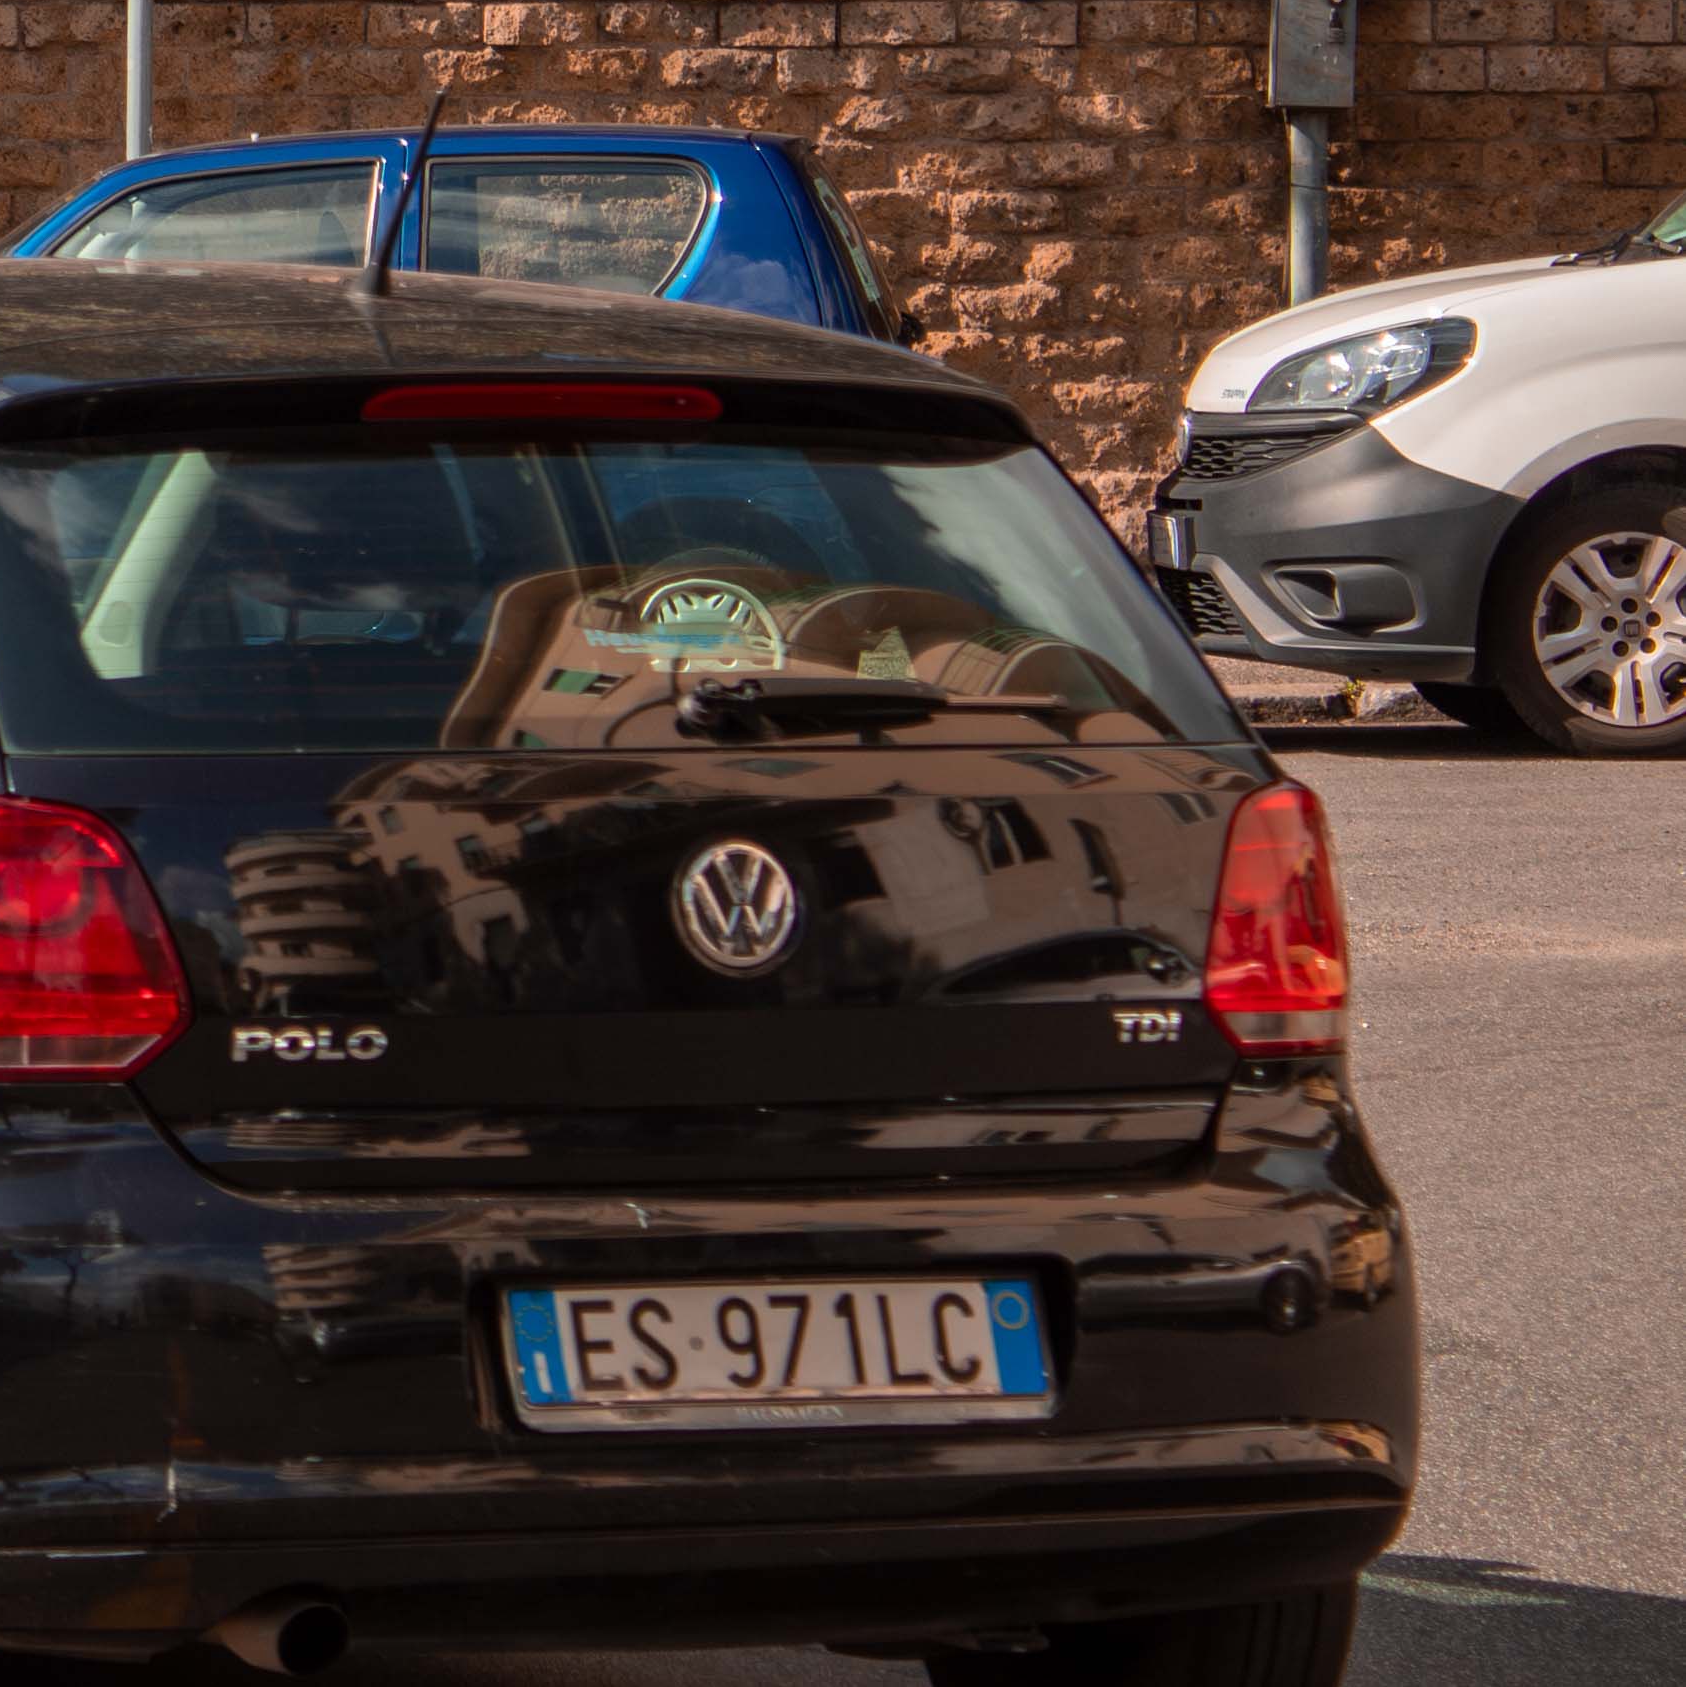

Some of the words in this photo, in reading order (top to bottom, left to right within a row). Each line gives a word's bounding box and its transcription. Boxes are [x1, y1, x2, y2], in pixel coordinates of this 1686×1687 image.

[231, 1025, 389, 1062] POLO
[1112, 1009, 1183, 1045] TDI
[569, 1293, 680, 1392] ES
[715, 1290, 984, 1390] 971LC
